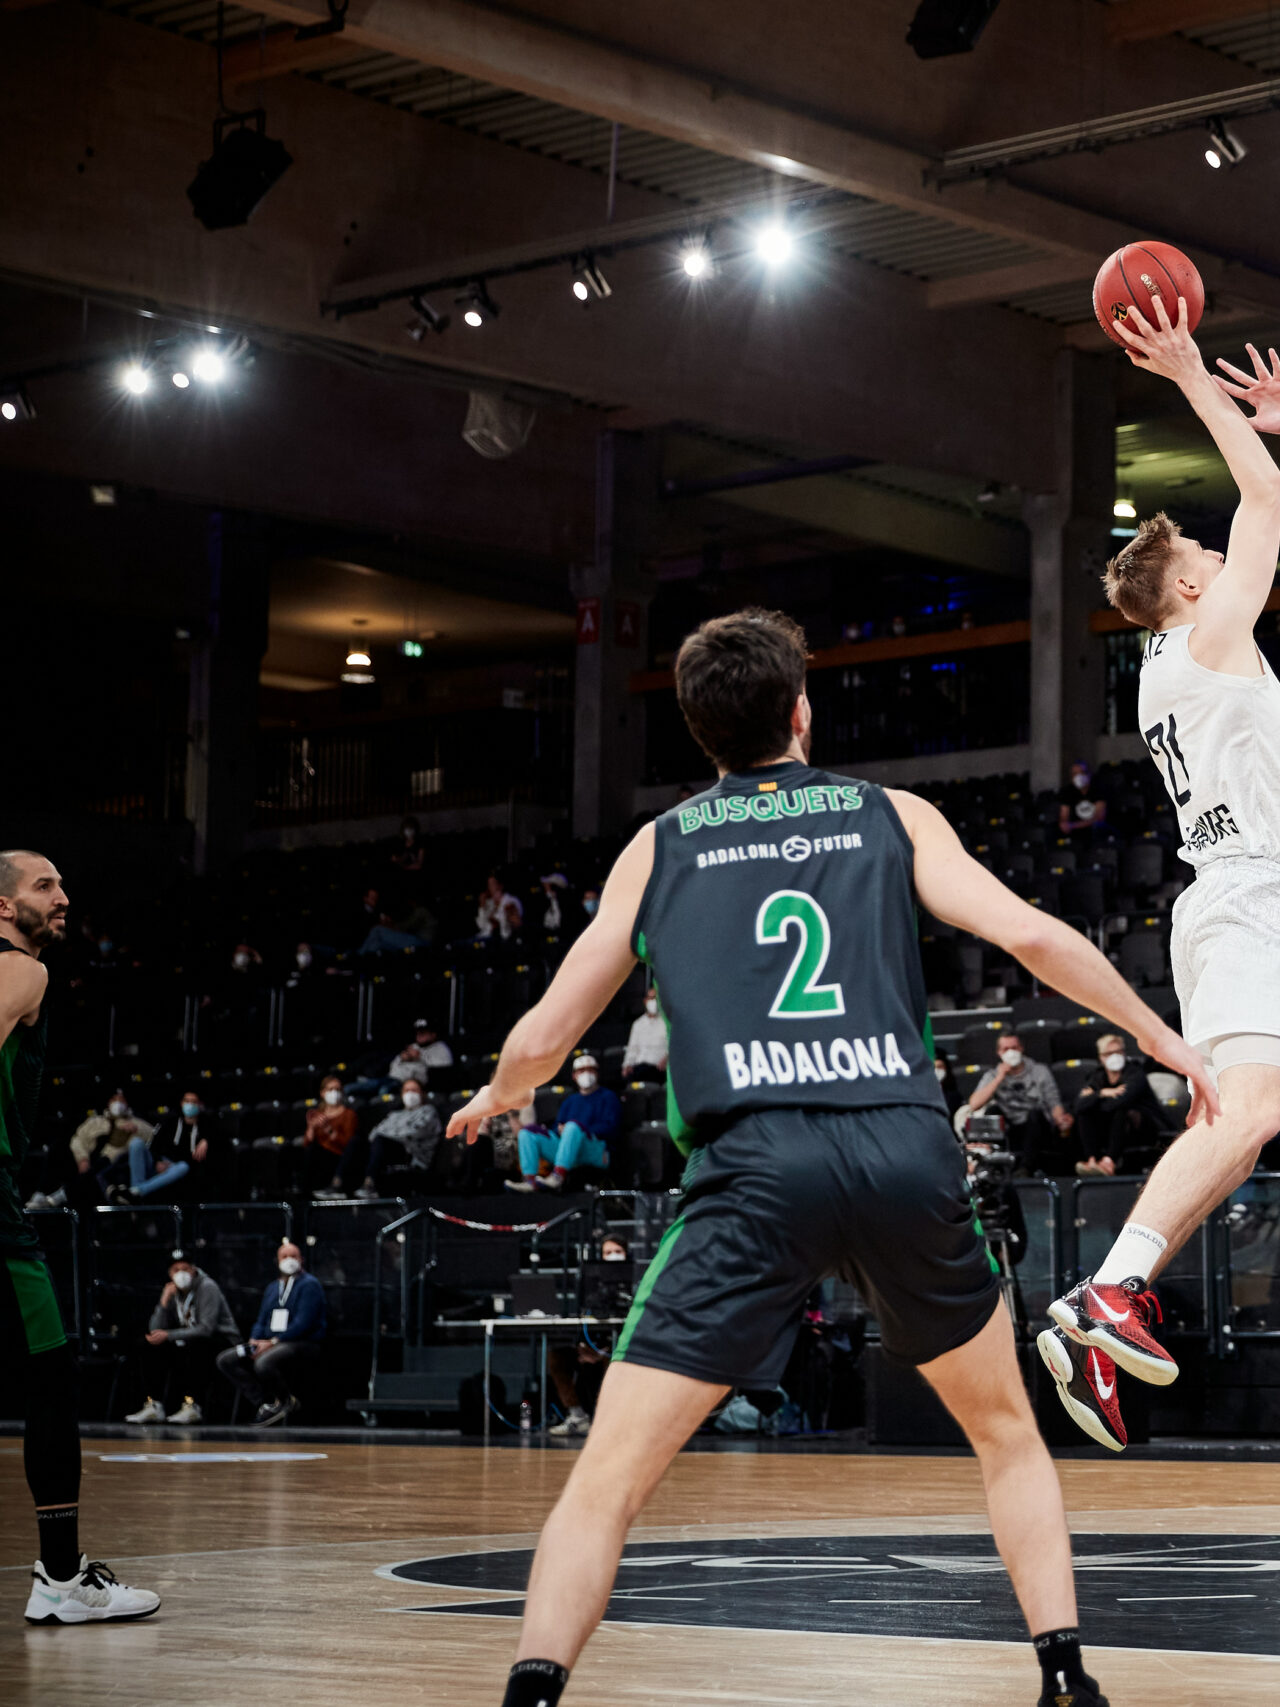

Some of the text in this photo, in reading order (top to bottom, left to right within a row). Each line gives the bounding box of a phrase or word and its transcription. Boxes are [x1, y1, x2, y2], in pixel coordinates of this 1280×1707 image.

[580, 608, 595, 633] A
[679, 785, 863, 834] BUSQUETS
[696, 833, 863, 869] BADALONA FUTUR
[755, 889, 846, 1019] 2
[723, 1032, 912, 1091] BADALONA
